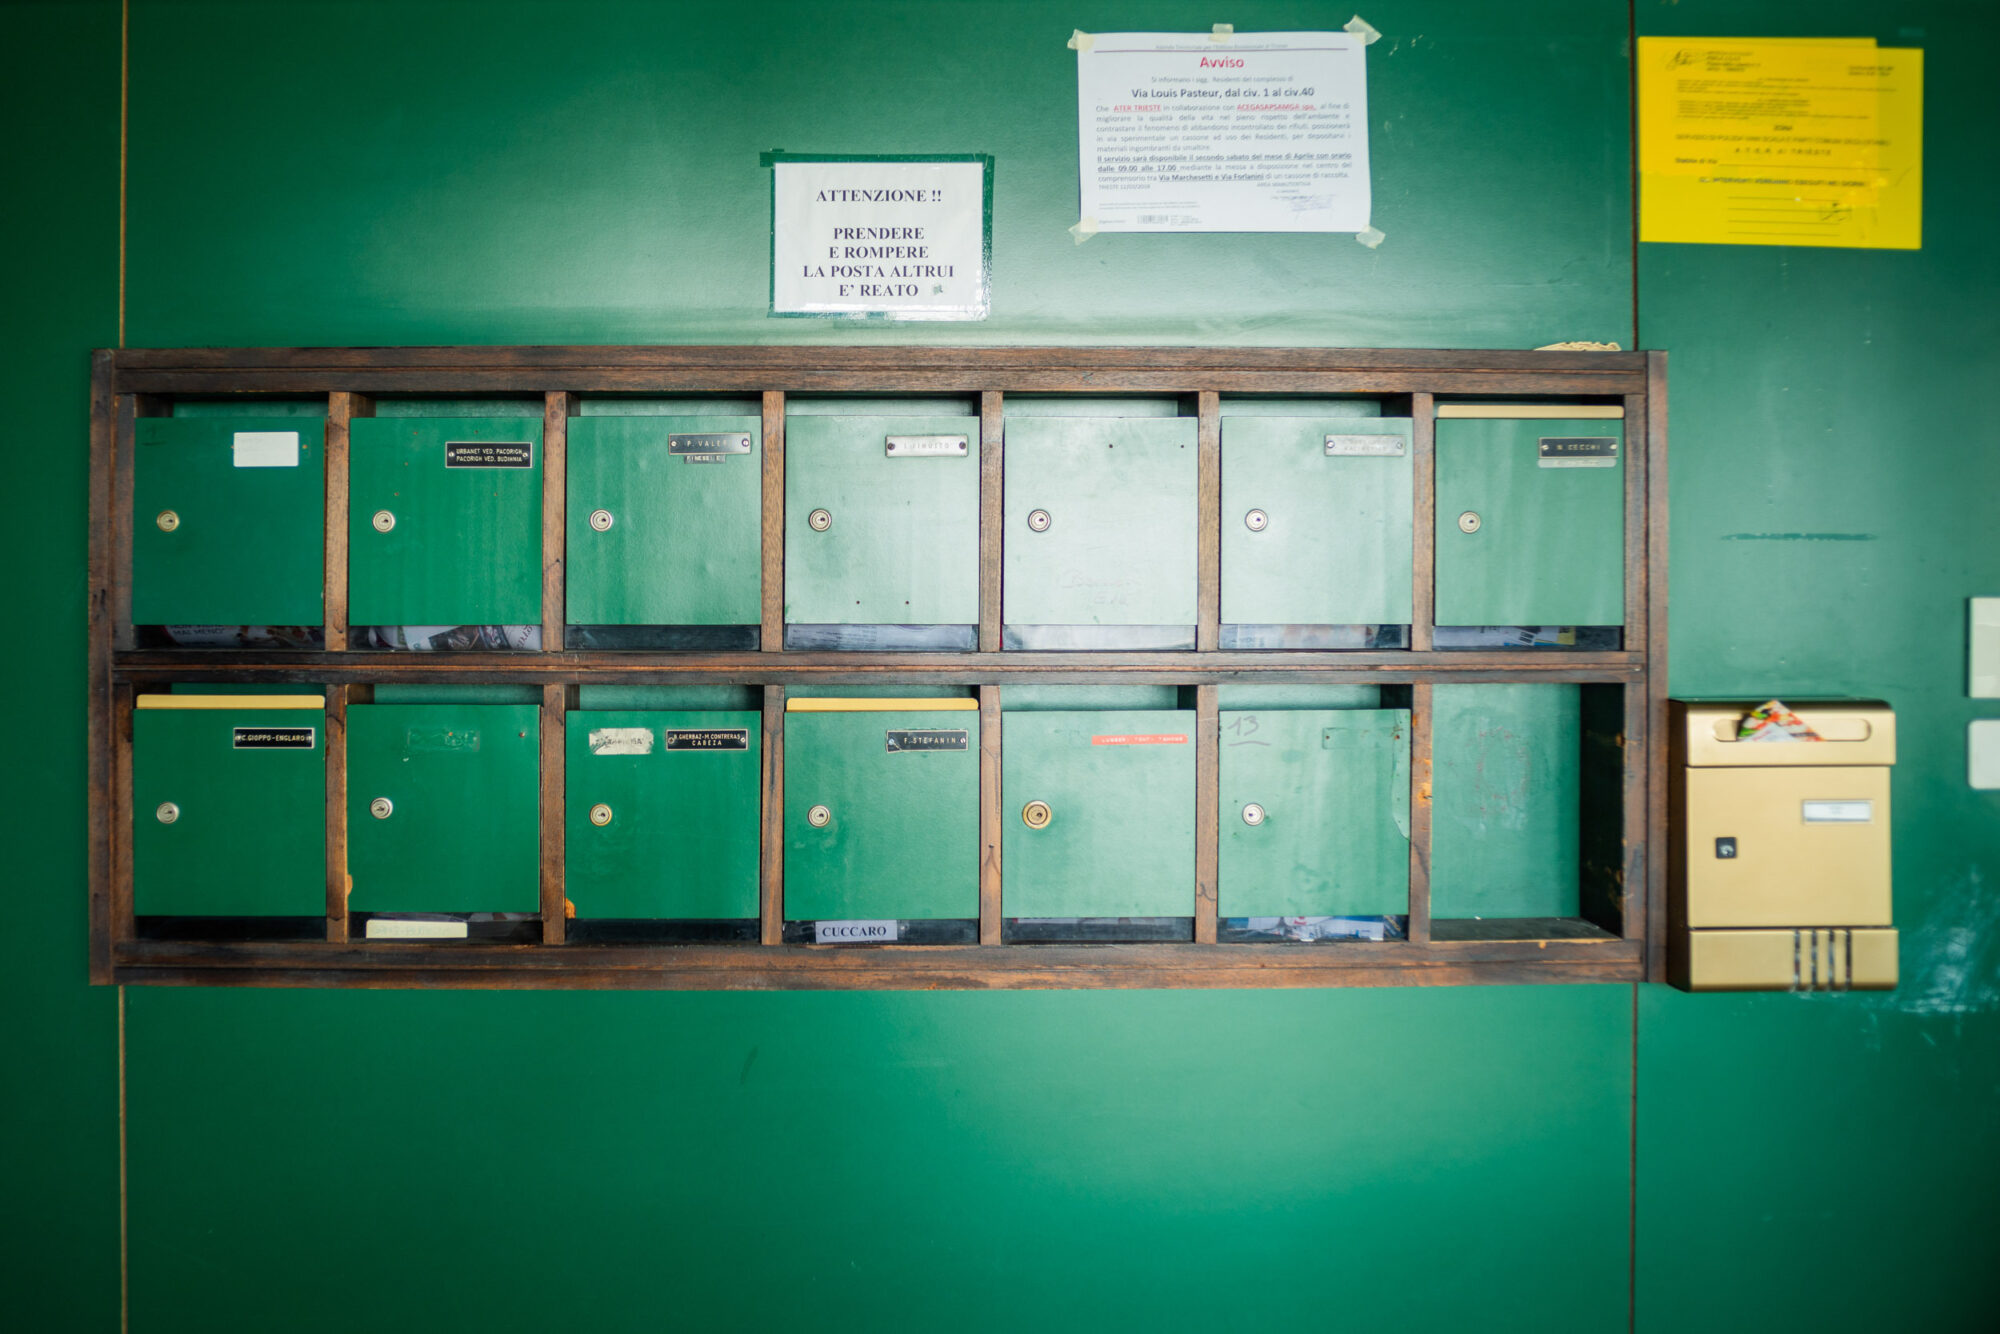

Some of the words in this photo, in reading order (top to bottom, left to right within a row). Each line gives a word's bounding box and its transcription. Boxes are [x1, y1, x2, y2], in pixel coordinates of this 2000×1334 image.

[1200, 55, 1244, 68] Avviso
[1132, 88, 1148, 98] Via
[1150, 88, 1178, 98] Louis
[1180, 88, 1222, 100] Pasteur,
[1224, 88, 1240, 98] dal
[1243, 88, 1260, 98] civ.
[1264, 88, 1269, 97] 1
[1272, 87, 1282, 97] al
[1284, 86, 1314, 96] civ.40
[1096, 104, 1109, 112] Che
[1172, 104, 1220, 112] collaborazione
[1133, 154, 1147, 162] sarà
[816, 190, 927, 202] ATTENZIONE
[932, 190, 942, 202] !!
[833, 227, 925, 240] PRENDERE
[829, 246, 839, 258] E
[844, 246, 929, 258] ROMPERE
[803, 265, 825, 278] LA
[830, 264, 885, 278] POSTA
[890, 264, 954, 278] ALTRUI
[860, 284, 919, 296] REATO
[1226, 715, 1260, 736] 13
[822, 926, 887, 937] CUCCARO
